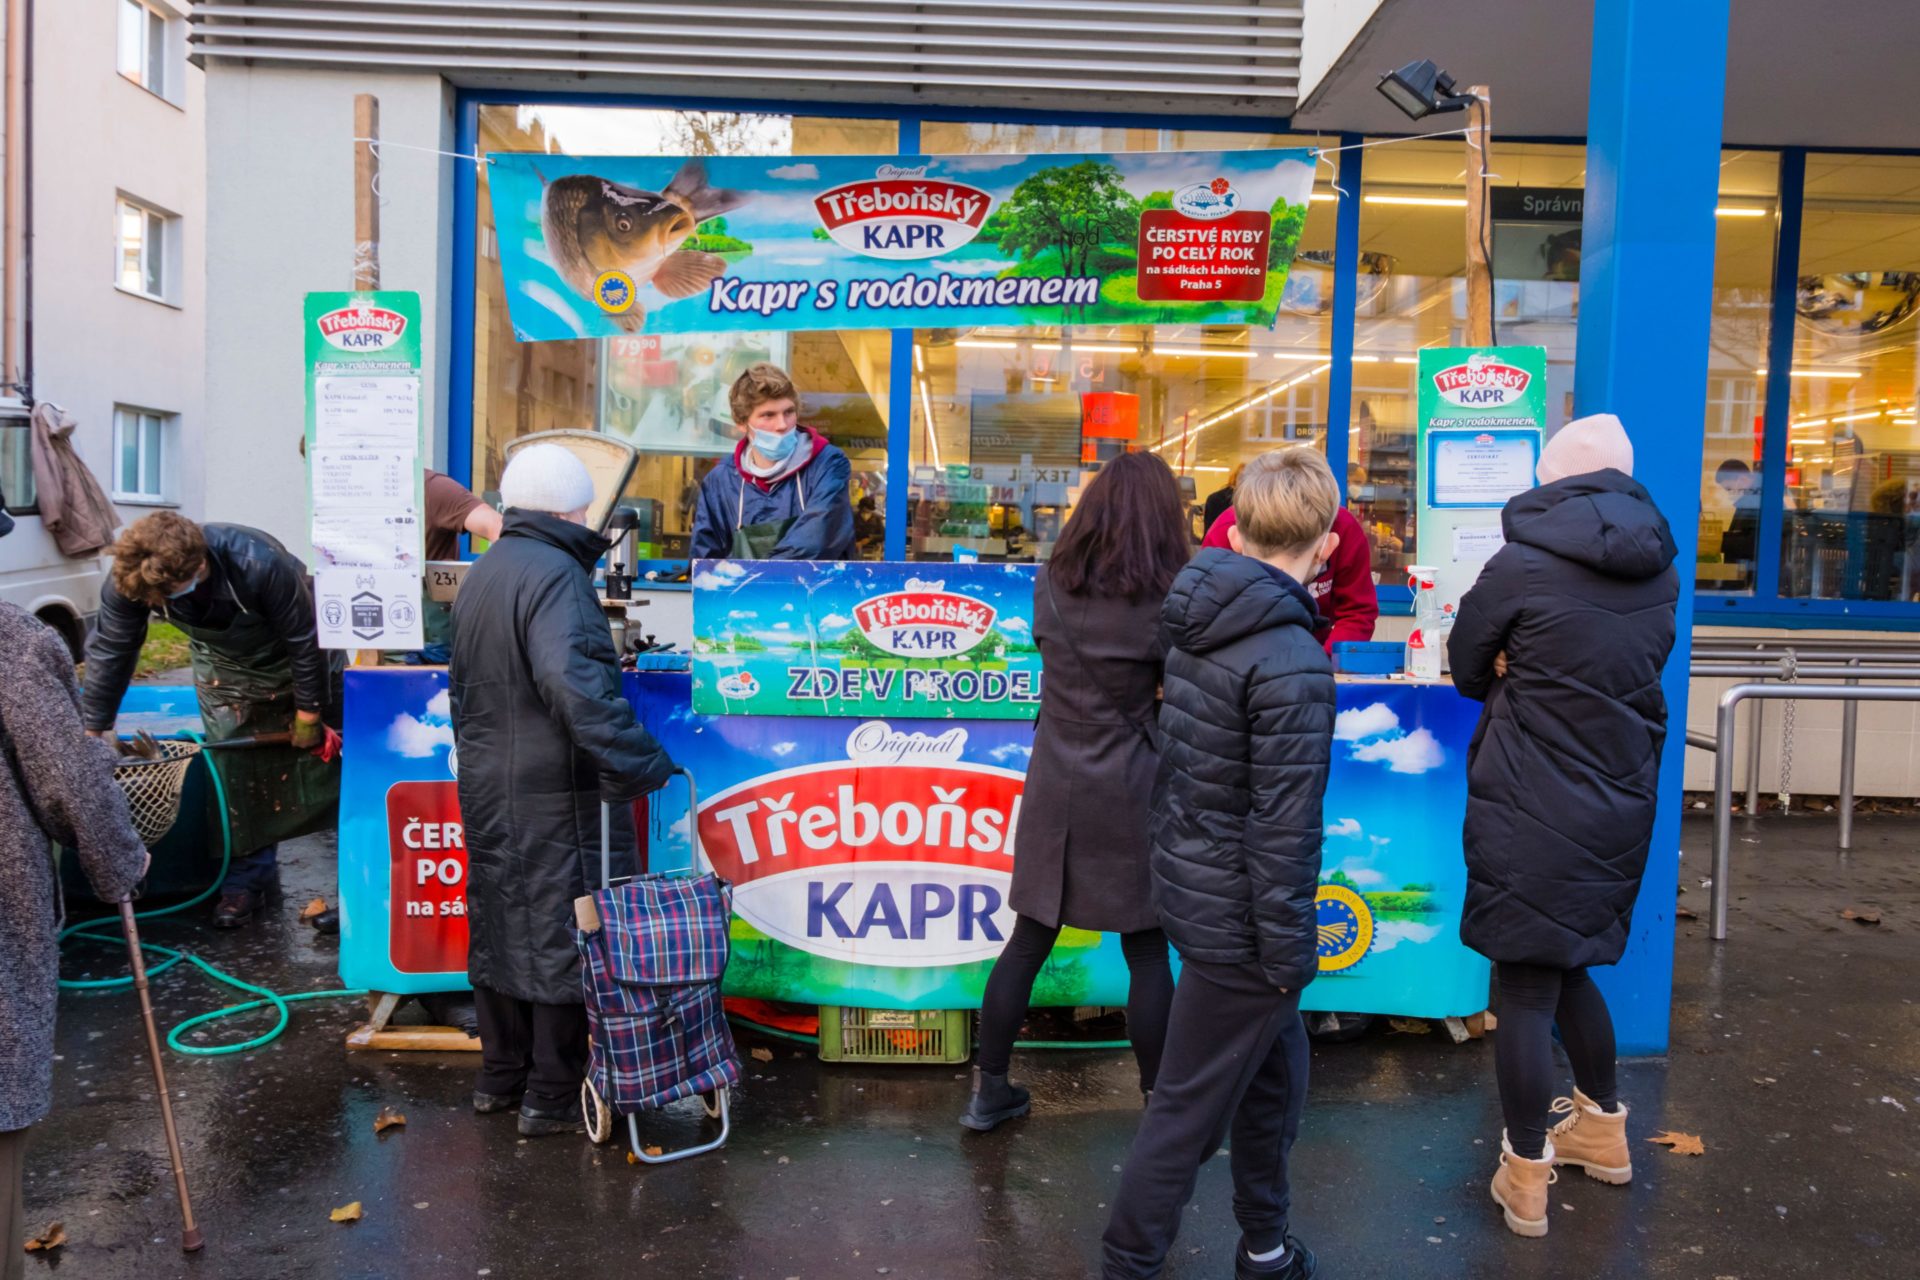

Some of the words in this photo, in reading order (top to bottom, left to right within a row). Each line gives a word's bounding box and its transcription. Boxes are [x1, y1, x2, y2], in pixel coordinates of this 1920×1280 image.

[822, 186, 981, 224] Třeboňský
[863, 224, 945, 249] KAPR
[1146, 226, 1217, 243] ČERSTVÉ
[1221, 230, 1263, 243] RYBY
[1152, 246, 1175, 260] PO
[1178, 244, 1217, 260] CELÝ
[1220, 247, 1255, 260] ROK
[1146, 266, 1160, 275] na
[1162, 264, 1208, 275] sádkách
[1210, 265, 1260, 275] Lahovice
[709, 277, 807, 315] Kapr
[814, 279, 838, 310] s
[846, 274, 1099, 309] rodokmenem
[1180, 279, 1212, 289] Praha
[1214, 279, 1222, 289] 5
[342, 333, 383, 347] KAPR
[1439, 367, 1524, 390] Třeboňský
[1459, 389, 1505, 403] KAPR
[1429, 417, 1456, 428] Kapr
[1457, 418, 1463, 427] s
[1466, 416, 1536, 427] rodokmenem
[892, 630, 957, 650] KAPR
[788, 668, 862, 699] ZDE
[867, 668, 895, 700] V
[854, 723, 962, 763] Originál
[402, 817, 463, 849] ČER
[417, 858, 463, 885] PO
[406, 900, 434, 916] na
[440, 895, 468, 916] sá
[806, 881, 1005, 942] KAPR
